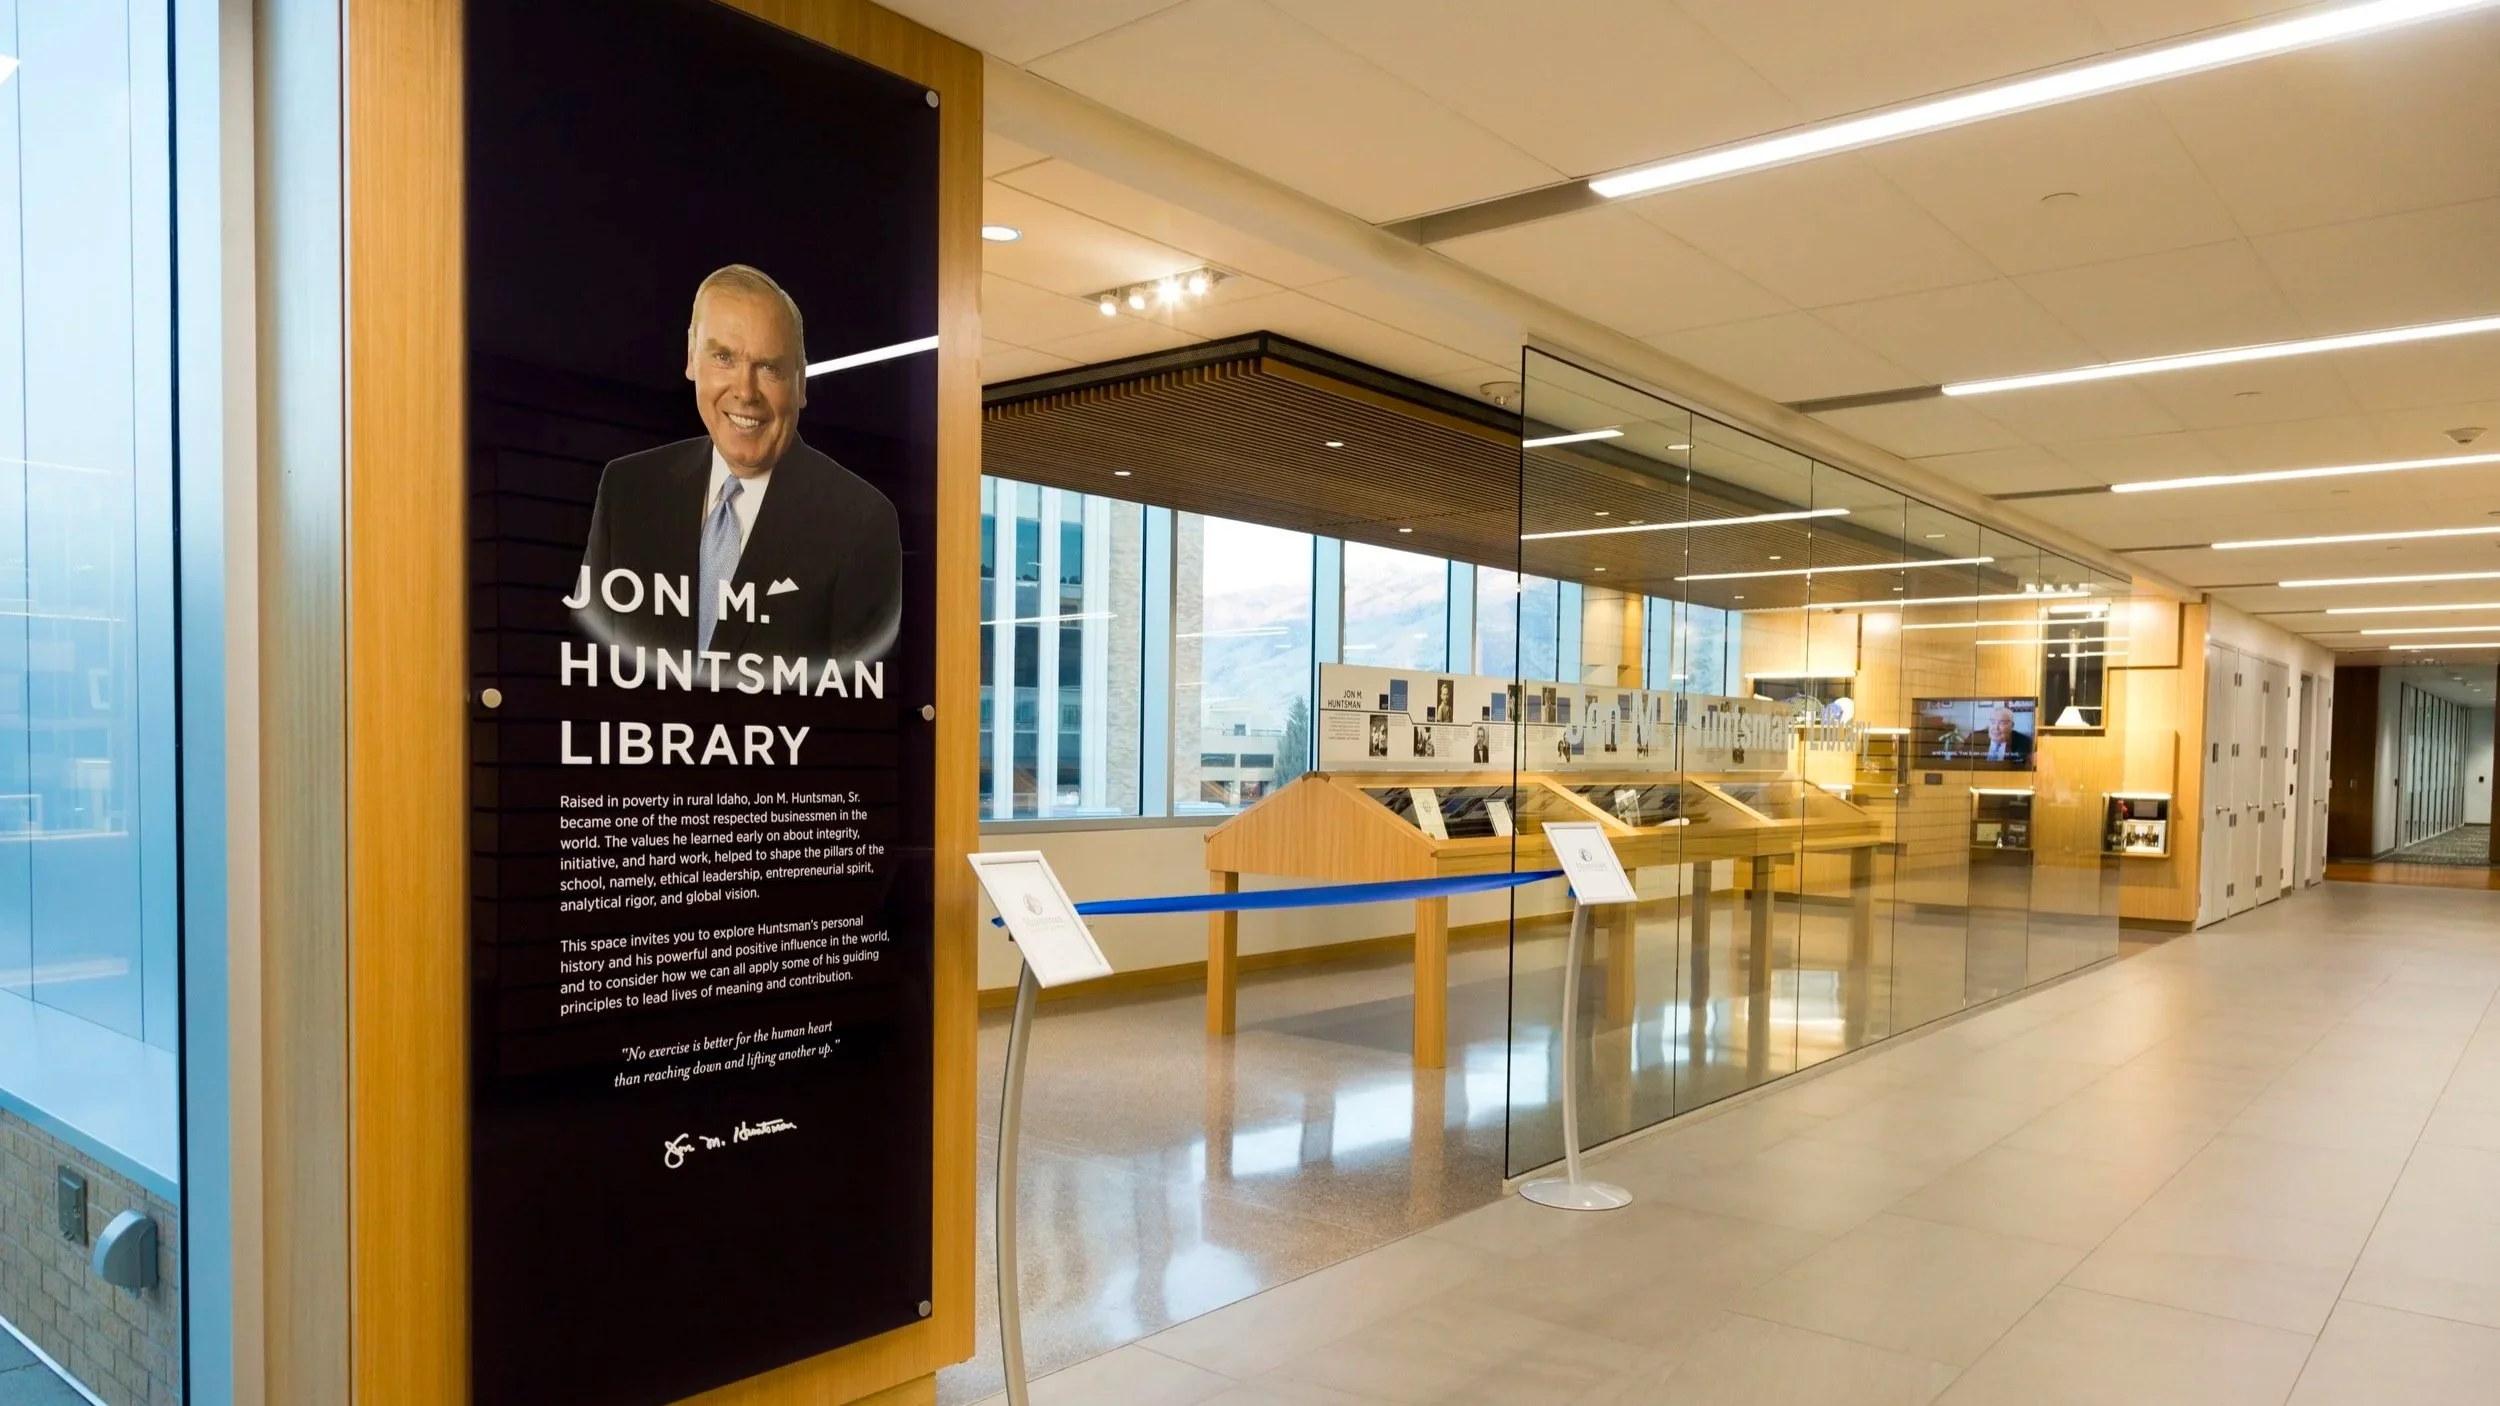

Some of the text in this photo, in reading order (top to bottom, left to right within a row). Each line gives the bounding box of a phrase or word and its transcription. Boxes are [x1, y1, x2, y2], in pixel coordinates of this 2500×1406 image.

[562, 565, 770, 624] JON M.
[561, 641, 884, 699] HUNTSMAN
[1327, 699, 1361, 709] HUNTSMAN
[1343, 689, 1356, 699] JON
[1565, 684, 1621, 746] Jon
[1686, 691, 1795, 751] Huntsman
[561, 720, 810, 766] LIBRARY
[559, 790, 861, 809] Raised in poverty in rural Idaho, Jon M. Huntsman, Sr.
[559, 808, 868, 829] became one of the most respected businessmen in the
[559, 826, 860, 850] world. The values he learned early on about integrity,
[559, 843, 885, 870] initiative, and hard work, helped to shape the pillars of the
[559, 861, 874, 892] school, namely, ethical leadership, entrepreneurial spirit,
[559, 886, 760, 912] analytical rigor, and global vision.
[559, 914, 864, 953] This space invites you to explore Huntsman's personal
[559, 929, 890, 974] history and his powerful and positive influence in the world,
[559, 949, 880, 994] and to consider how we can all apply some of his guiding
[560, 970, 854, 1017] principles to lead lives of meaning and contribution.
[649, 1041, 689, 1059] exercise
[692, 1041, 700, 1052] is
[703, 1036, 733, 1050] better
[734, 1031, 751, 1050] for
[753, 1029, 768, 1043] the
[771, 1027, 805, 1040] human
[808, 1021, 832, 1035] heart
[614, 1073, 640, 1087] than
[644, 1063, 690, 1082] reaching
[693, 1059, 722, 1075] down
[724, 1056, 744, 1070] and
[746, 1052, 776, 1070] lifting
[779, 1045, 815, 1061] another
